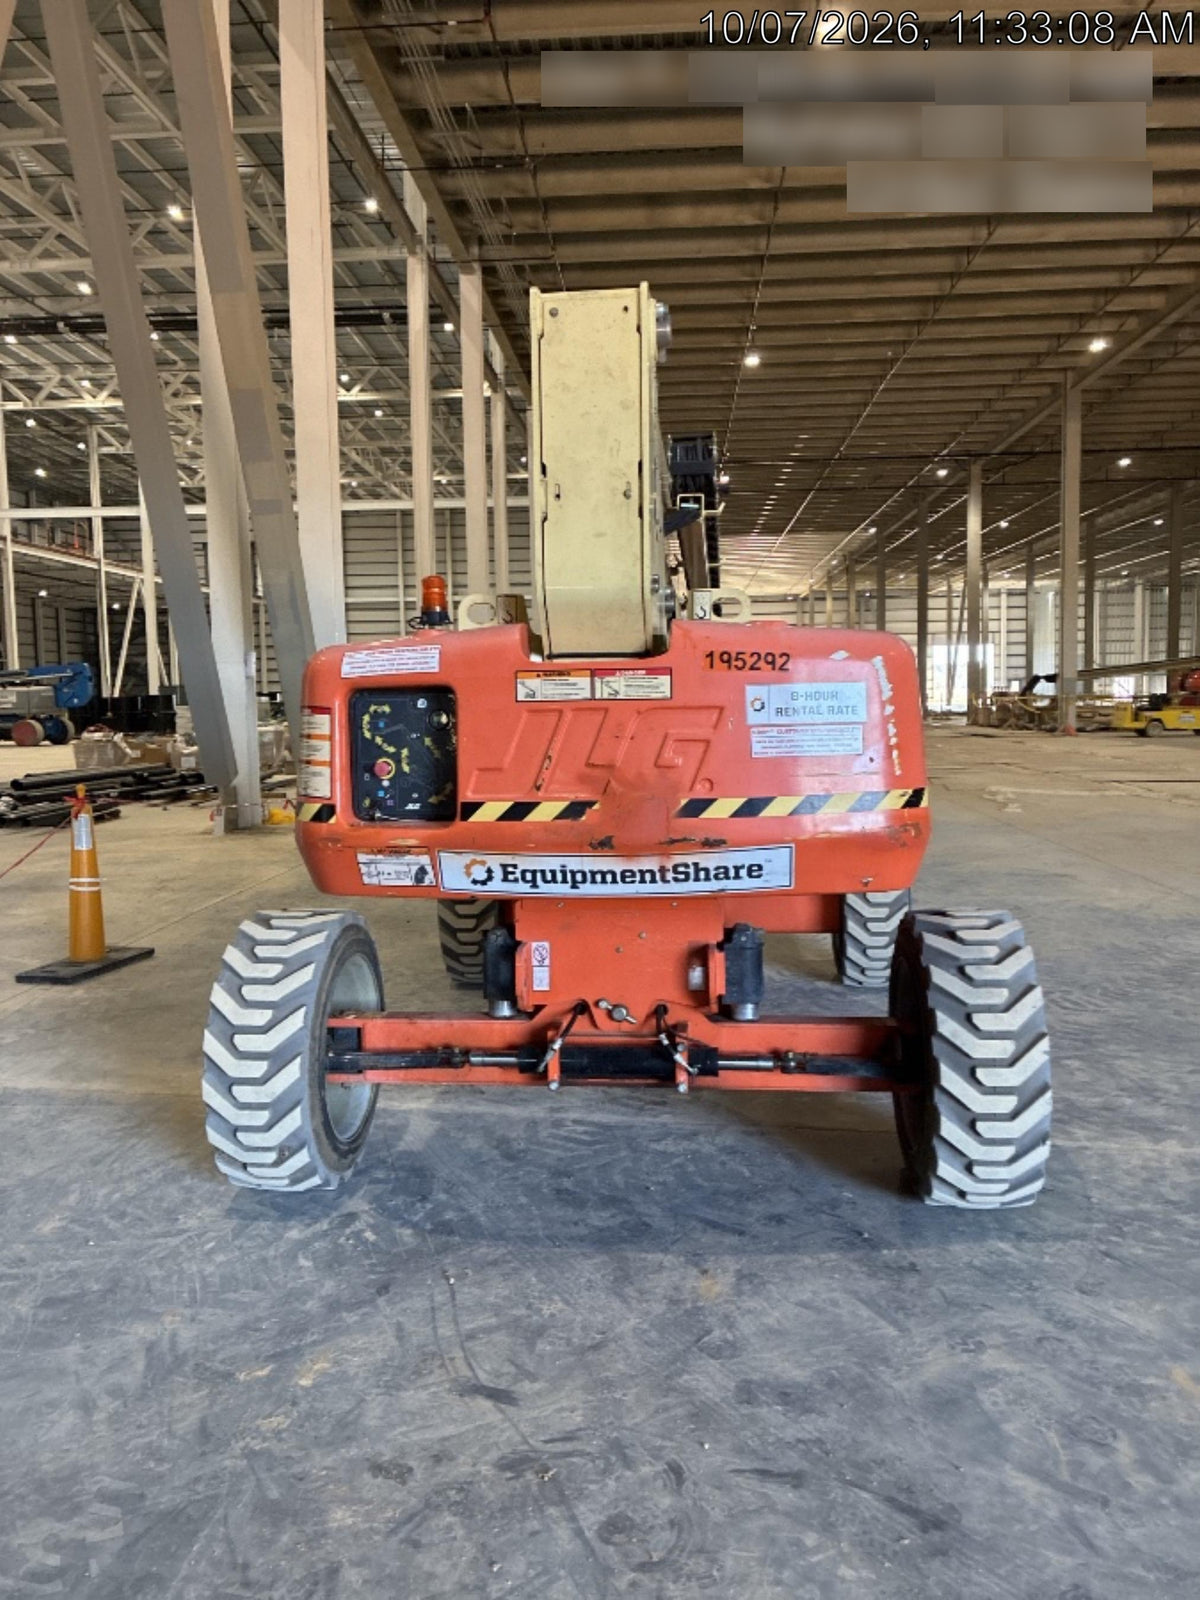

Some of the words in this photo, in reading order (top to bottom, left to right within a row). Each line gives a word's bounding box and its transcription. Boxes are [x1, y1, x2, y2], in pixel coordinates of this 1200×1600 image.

[704, 650, 791, 672] 195292
[790, 690, 839, 701] 8-HOUR
[775, 705, 824, 717] RENTAL
[827, 704, 859, 716] RATE
[466, 706, 725, 798] JLG
[499, 861, 765, 890] EquipmentShare
